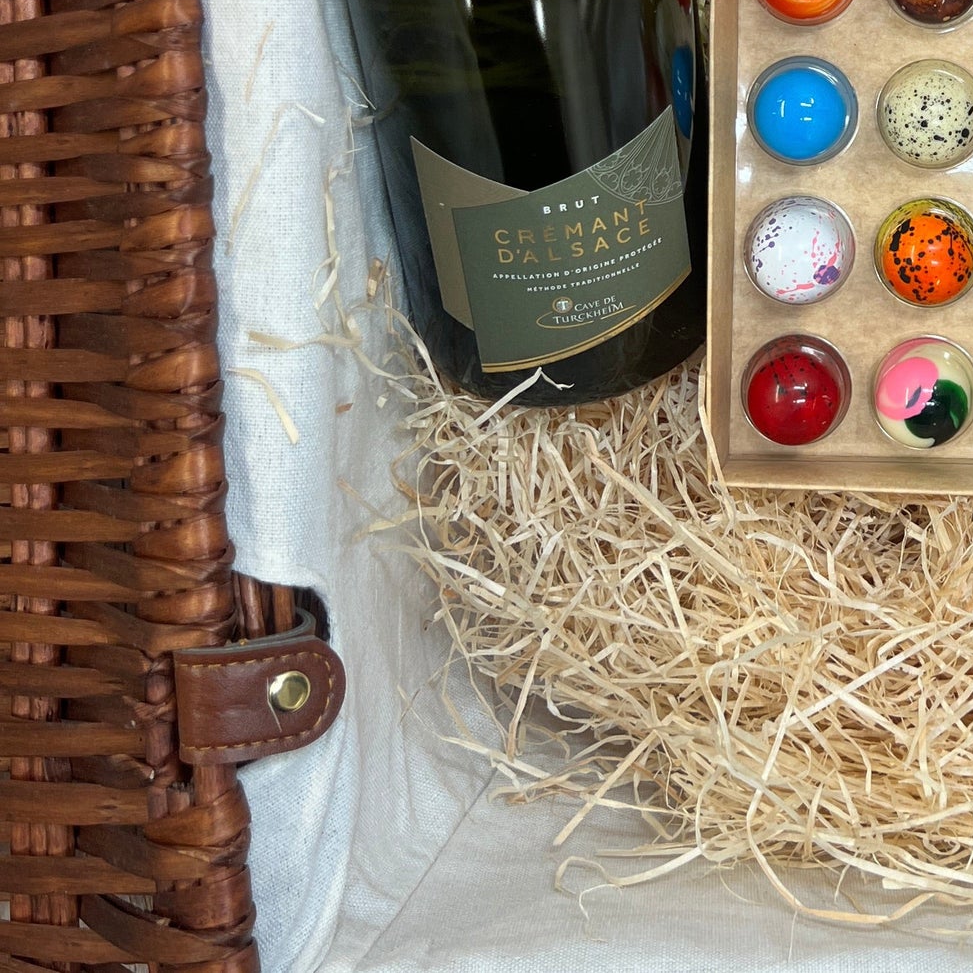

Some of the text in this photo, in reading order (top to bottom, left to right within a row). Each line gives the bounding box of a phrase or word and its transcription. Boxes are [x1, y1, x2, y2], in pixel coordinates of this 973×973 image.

[542, 195, 600, 215] BRUT
[498, 218, 650, 263] D'ALSACE
[492, 271, 560, 281] APPELLATION
[563, 258, 616, 277] D'ORIGINE
[526, 283, 568, 293] MÉTHODE
[552, 301, 624, 325] TURCKHEIM
[574, 294, 617, 312] CAVE DE
